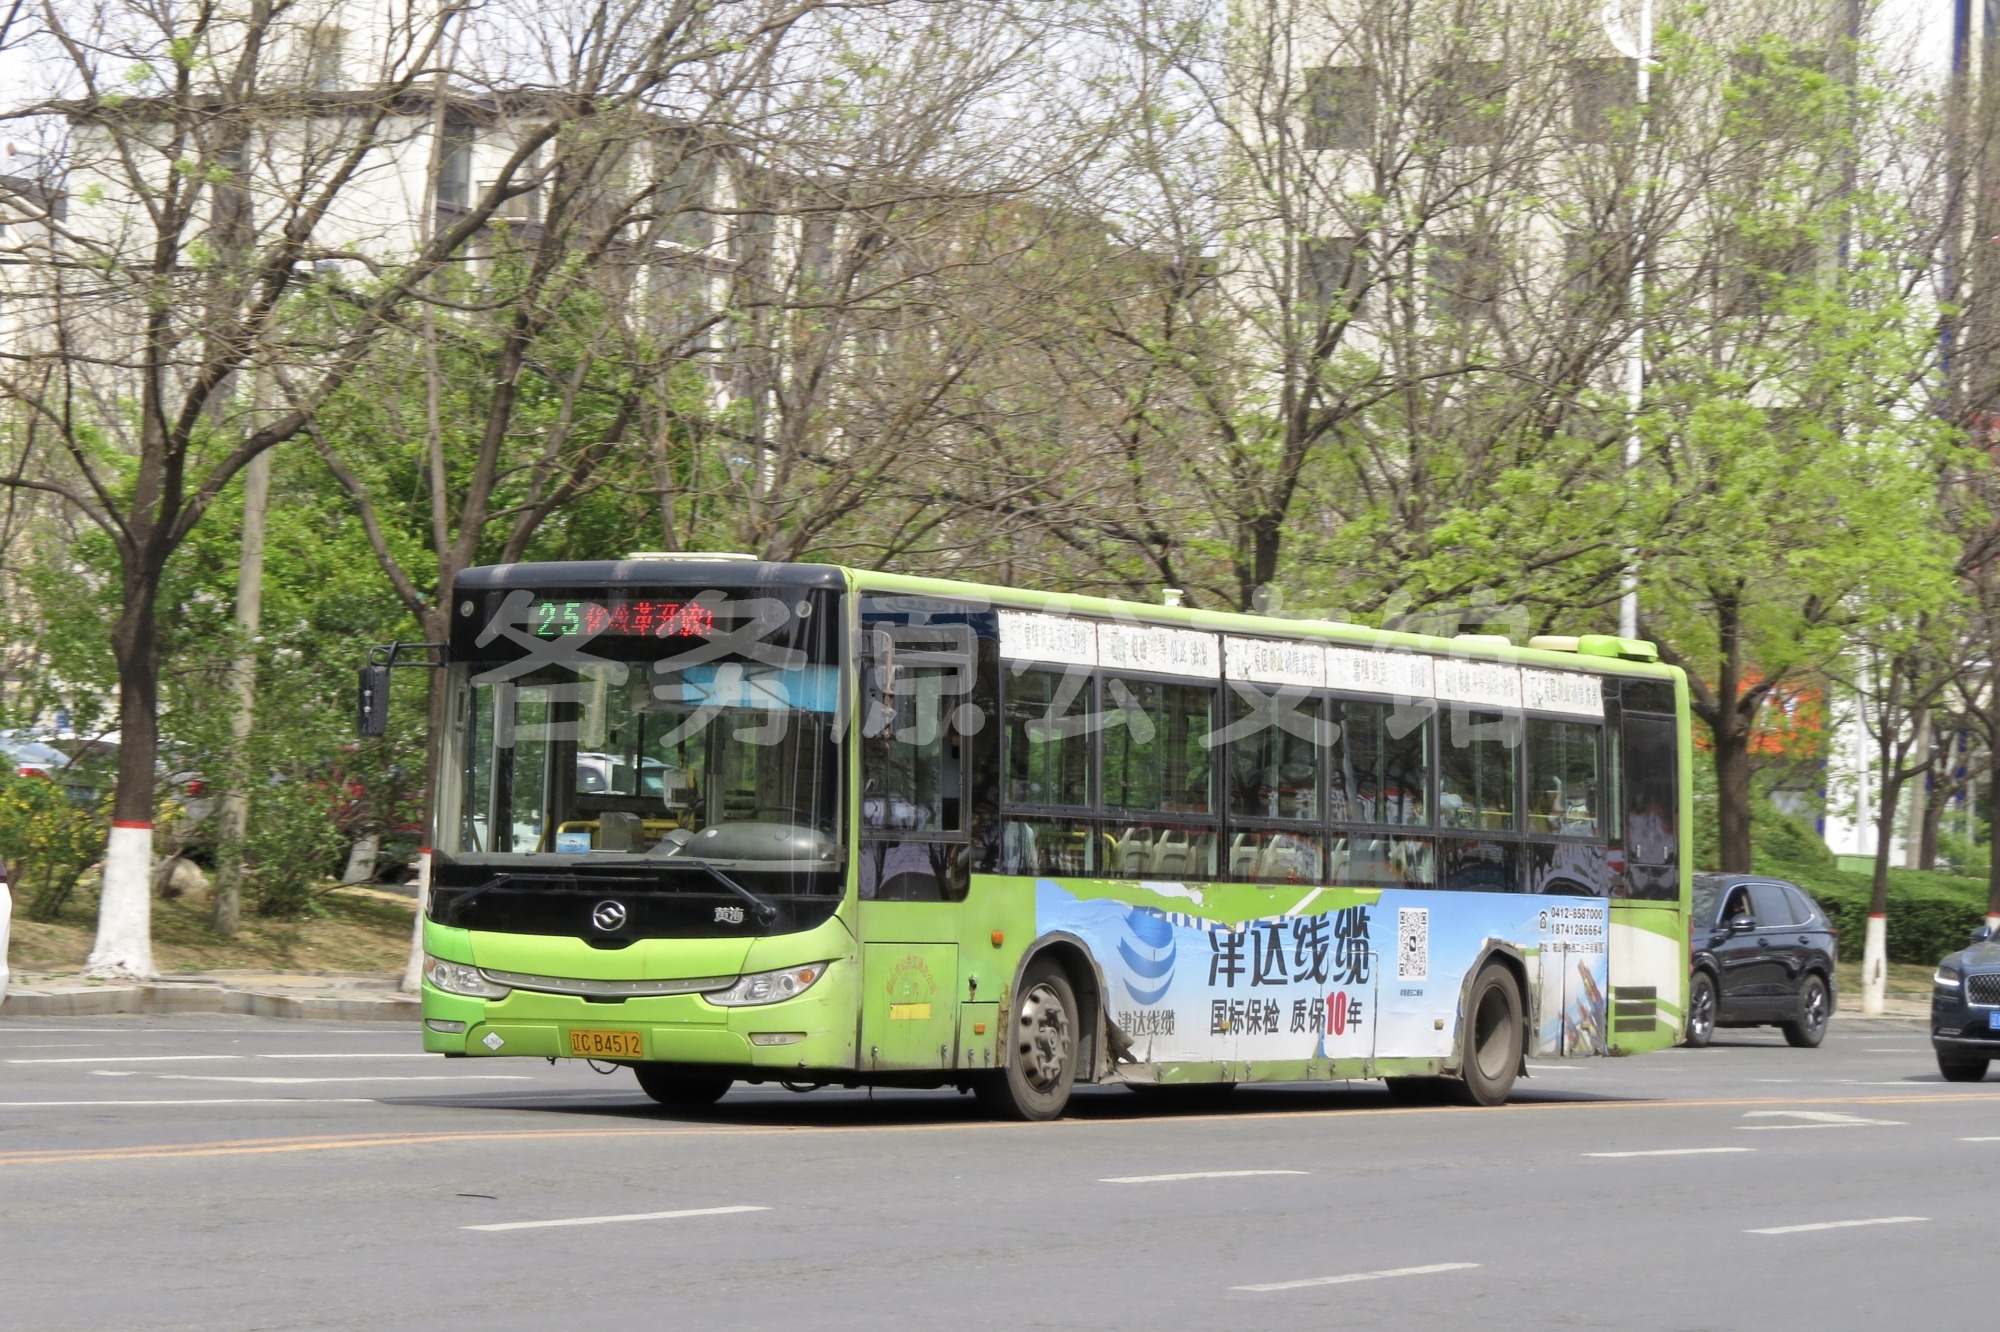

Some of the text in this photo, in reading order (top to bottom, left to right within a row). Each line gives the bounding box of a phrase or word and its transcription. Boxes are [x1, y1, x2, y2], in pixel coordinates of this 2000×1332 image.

[537, 602, 581, 635] 25
[714, 906, 744, 924] 黄海
[1551, 907, 1603, 920] 0412-8587000
[1551, 923, 1602, 936] 18741266664
[1207, 906, 1370, 988] 津达线缆
[1117, 1009, 1176, 1037] 津达线缆
[1210, 998, 1280, 1037] 国标保检
[1289, 991, 1363, 1036] 质保10年
[486, 1037, 501, 1046] LNG
